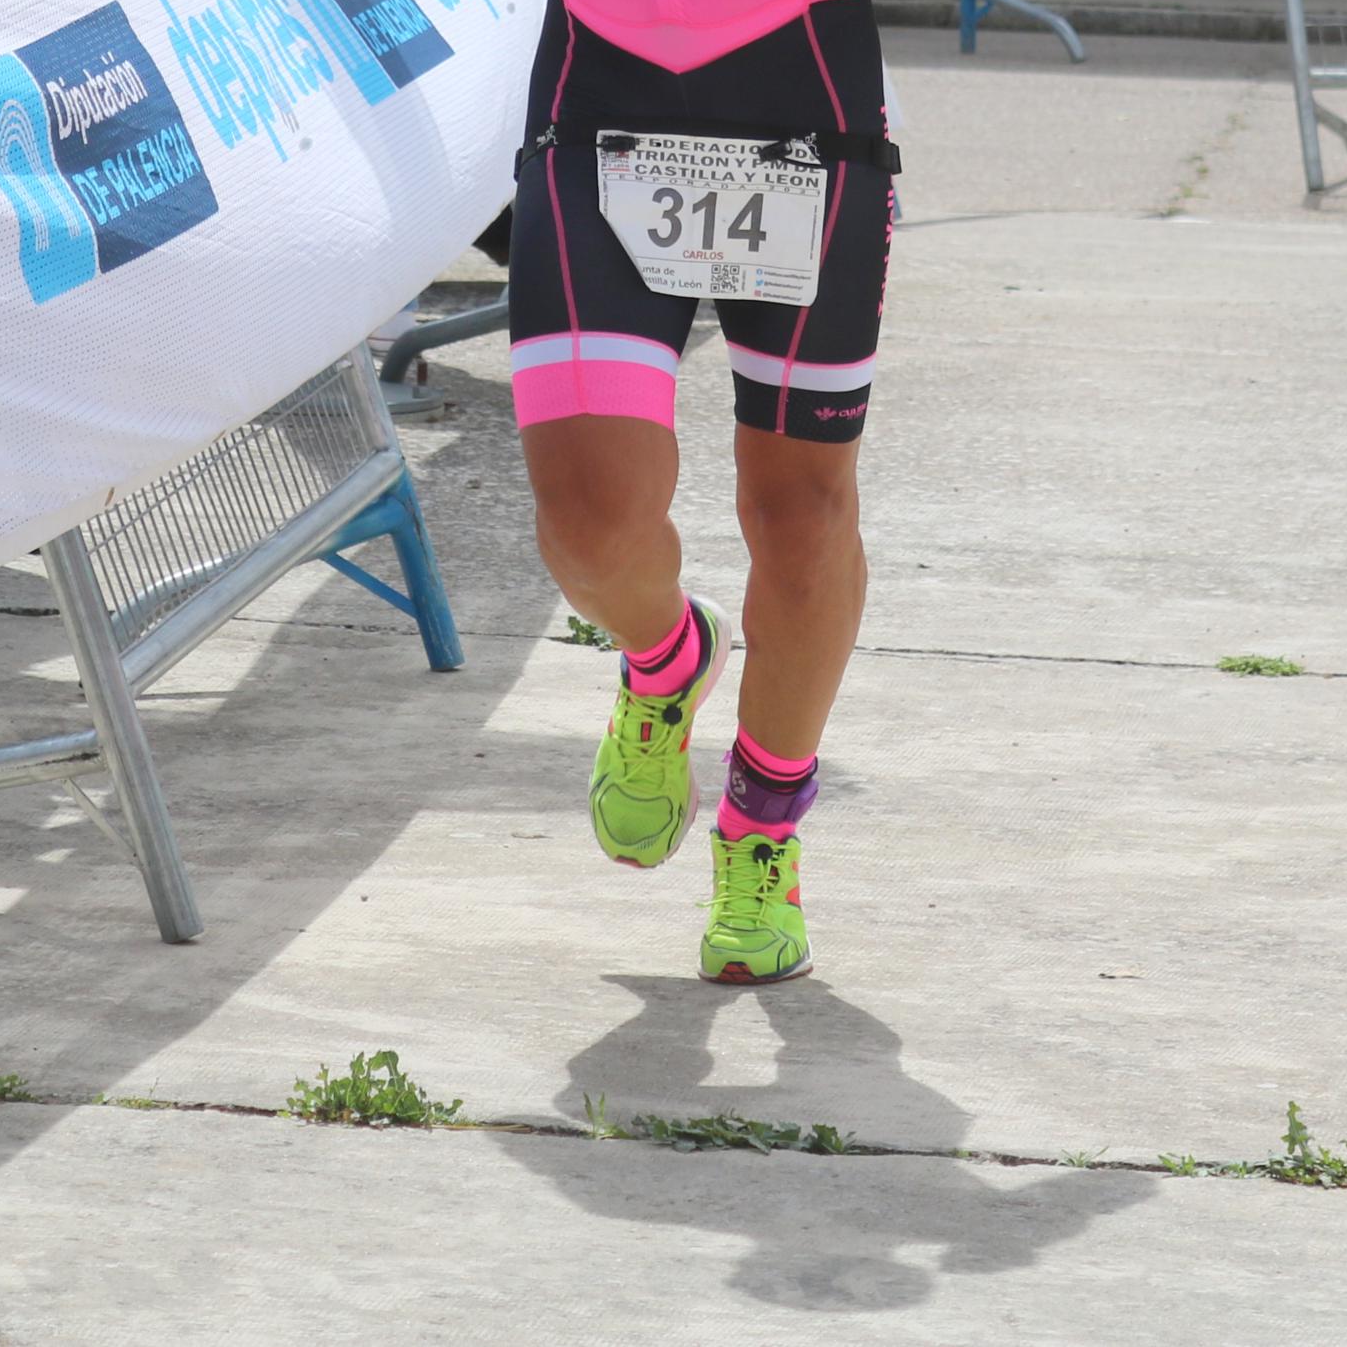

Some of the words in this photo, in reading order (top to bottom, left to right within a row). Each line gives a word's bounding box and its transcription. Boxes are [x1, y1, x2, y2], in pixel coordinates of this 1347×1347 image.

[353, 12, 390, 56] DE
[46, 51, 148, 144] Diputación
[635, 137, 763, 155] FEDERACIO
[635, 150, 729, 168] TRIATLON
[735, 158, 746, 168] Y
[72, 167, 121, 225] DE
[103, 123, 201, 211] PALENCIA
[635, 164, 735, 182] CASTILLA
[744, 172, 755, 182] Y
[765, 173, 819, 188] LEON
[647, 187, 767, 252] 314
[683, 250, 724, 260] CARLOS
[663, 267, 675, 276] de
[670, 281, 676, 289] y
[678, 279, 702, 289] León
